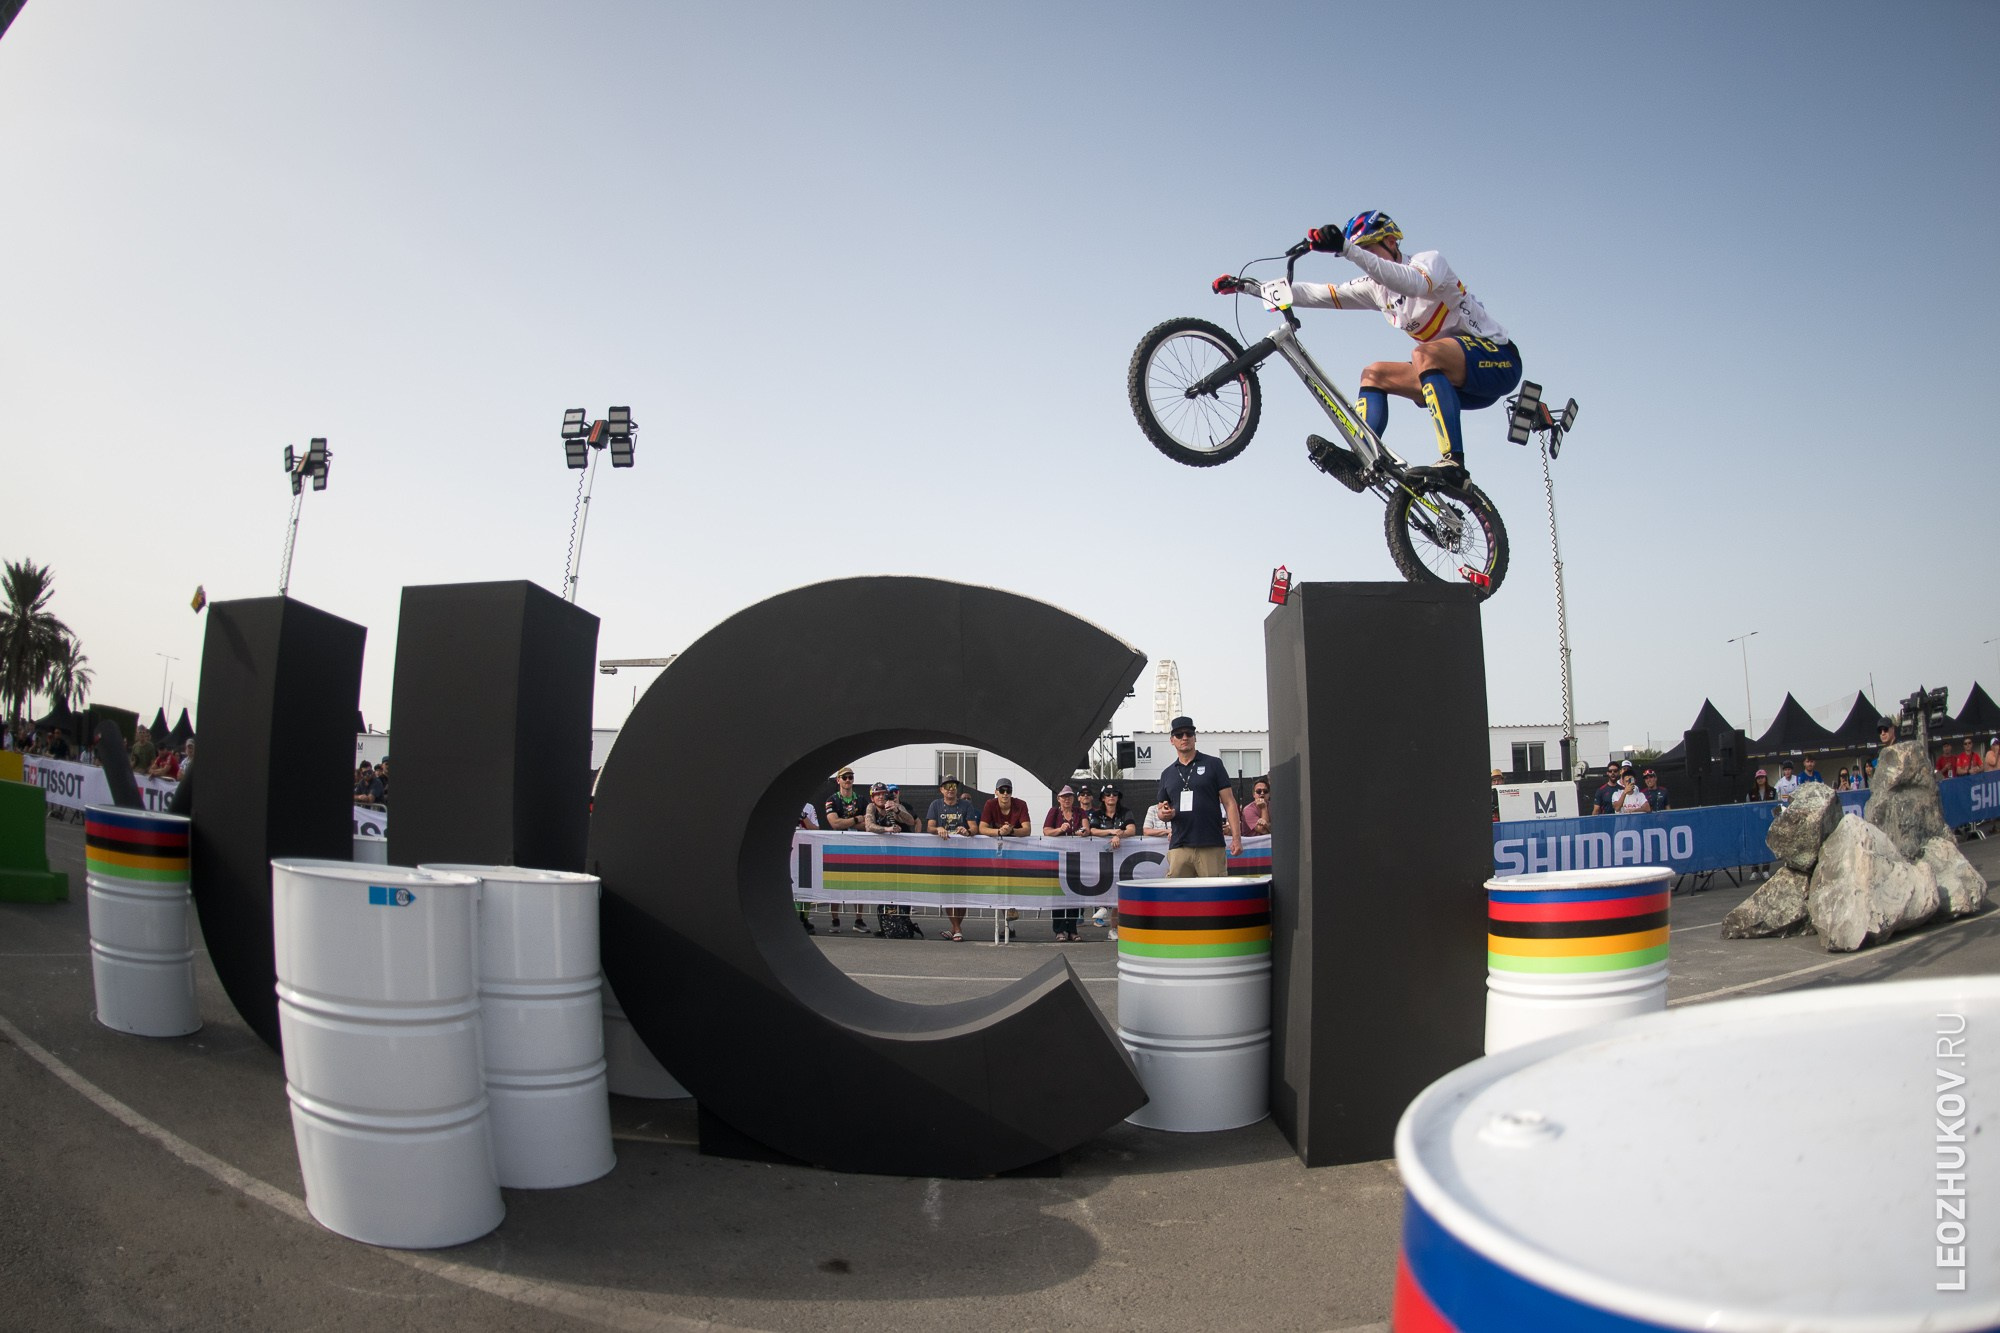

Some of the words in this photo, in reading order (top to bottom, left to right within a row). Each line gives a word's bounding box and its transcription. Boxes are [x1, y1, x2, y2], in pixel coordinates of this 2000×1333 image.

[38, 767, 84, 799] TISSOT
[1970, 780, 2000, 812] SHI
[145, 787, 173, 812] TIS
[1493, 825, 1694, 877] SHIMANO
[1065, 850, 1166, 897] UC
